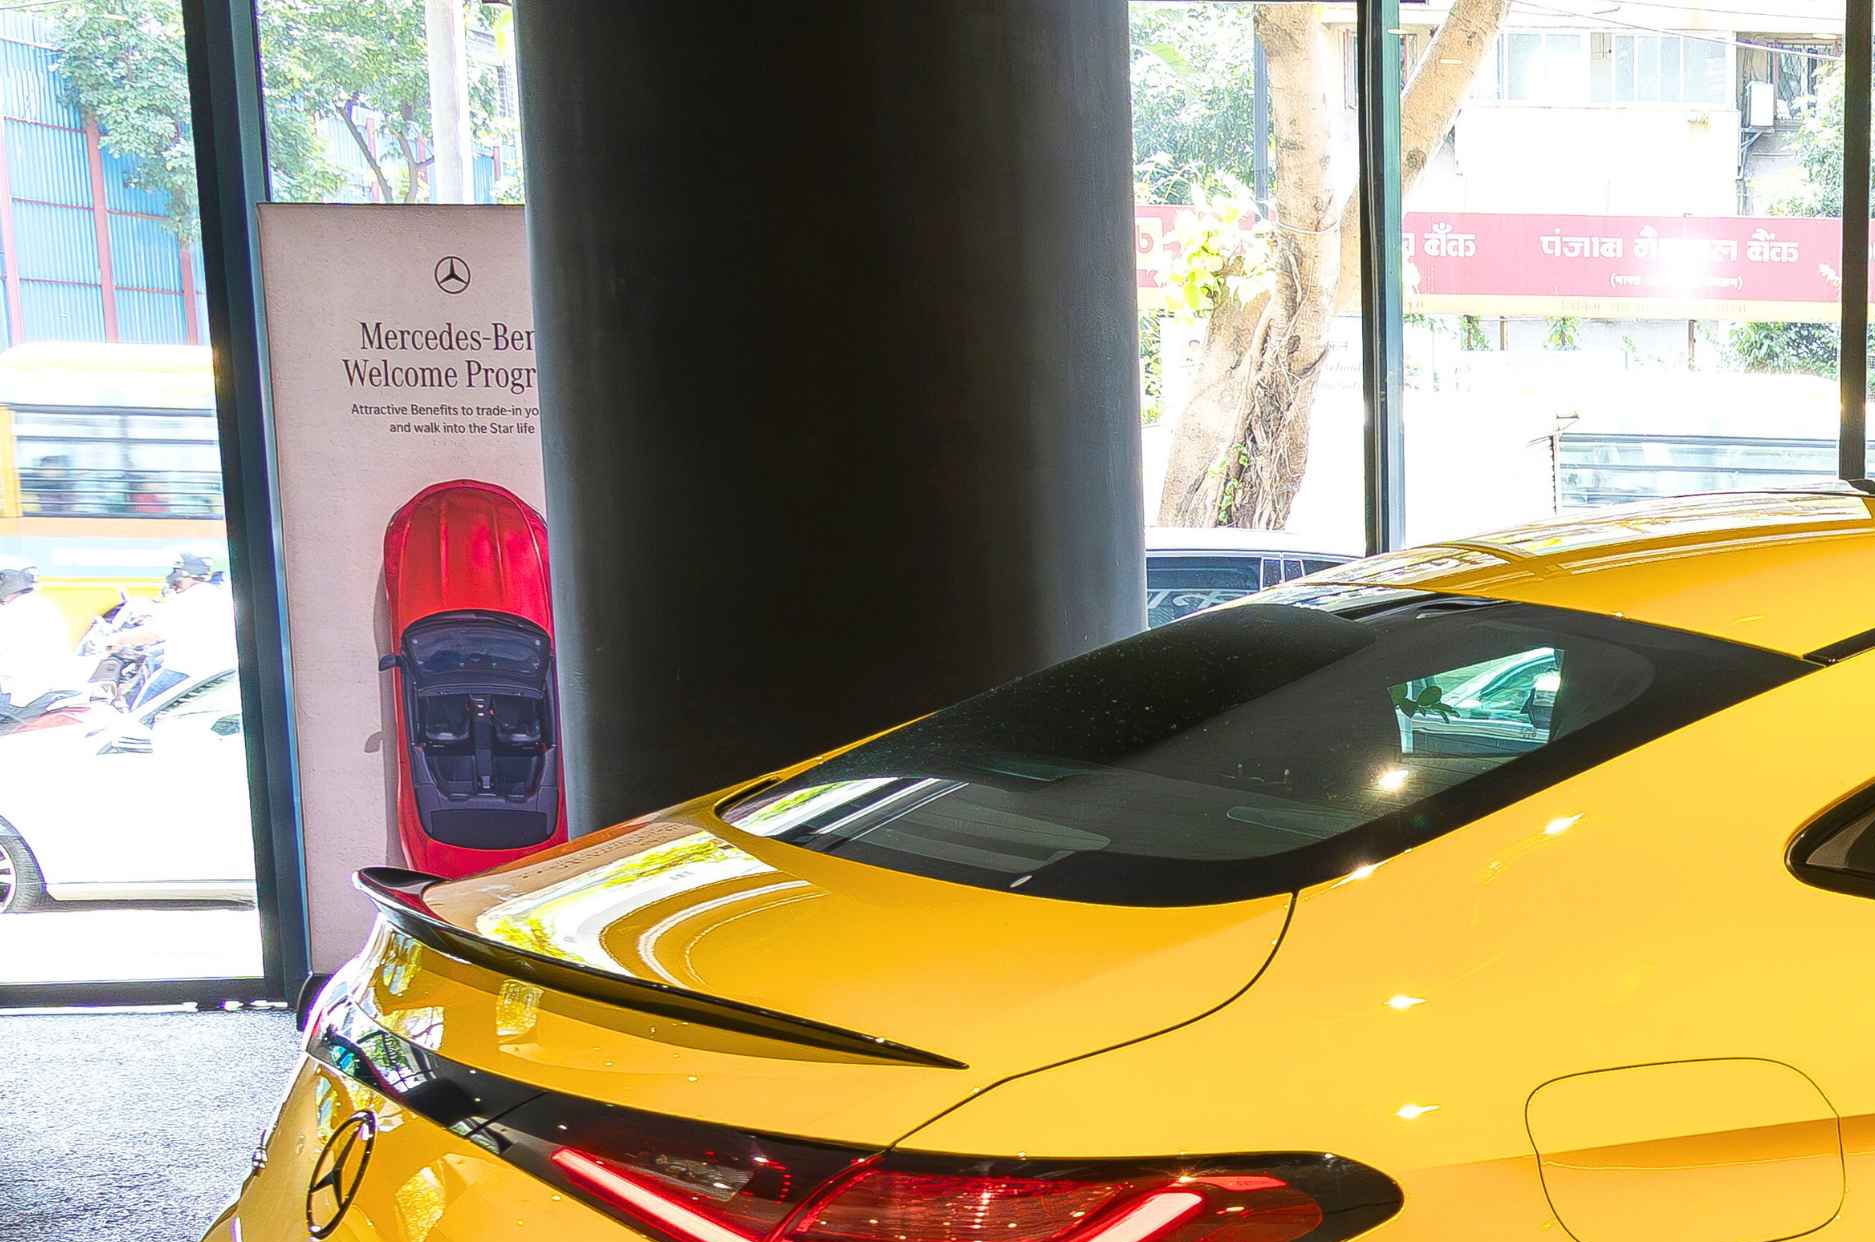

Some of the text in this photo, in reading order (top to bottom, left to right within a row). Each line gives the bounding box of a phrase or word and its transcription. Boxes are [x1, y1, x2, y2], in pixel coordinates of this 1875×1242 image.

[1539, 228, 1623, 258] पंजाब
[343, 358, 458, 388] Welcome
[352, 404, 407, 416] Attractive
[411, 404, 458, 416] Benefits
[461, 405, 473, 416] to
[476, 405, 522, 416] trade-in
[390, 422, 411, 434] and
[414, 422, 440, 434] walk
[444, 422, 466, 434] into
[469, 423, 488, 434] the
[490, 423, 514, 434] Star
